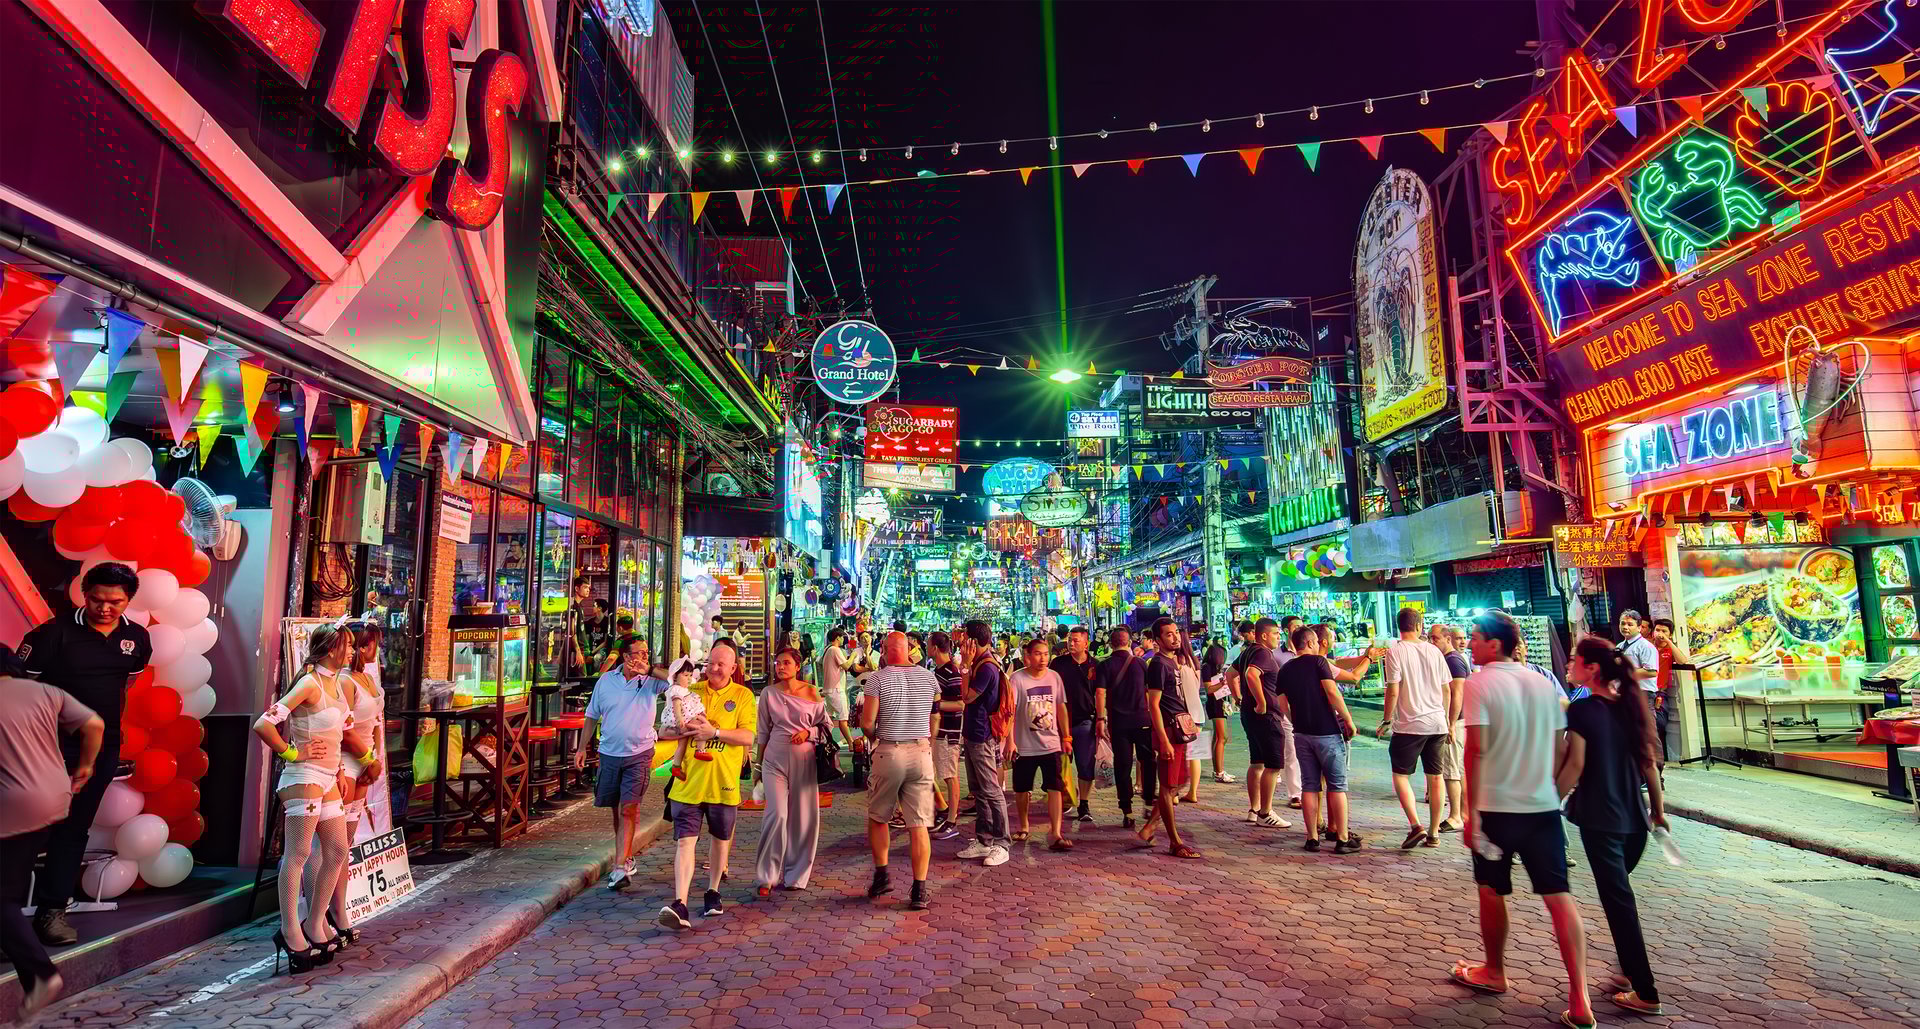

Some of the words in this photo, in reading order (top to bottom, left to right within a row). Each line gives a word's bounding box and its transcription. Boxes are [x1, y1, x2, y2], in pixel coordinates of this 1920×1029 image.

[1492, 47, 1619, 227] SEA
[1379, 208, 1401, 247] POT
[1422, 214, 1436, 278] FRESH
[1424, 281, 1438, 321] SEA
[1582, 313, 1665, 371] WELCOME
[1661, 300, 1695, 337] TO
[1697, 279, 1747, 322] SEA
[1746, 243, 1820, 302] ZONE
[1749, 292, 1850, 358] EXCELLENT
[1428, 322, 1442, 378] FOOD
[818, 367, 855, 380] Grand
[857, 368, 889, 380] Hotel
[1208, 361, 1274, 383] LOBSTER
[1279, 362, 1309, 377] POT
[1566, 388, 1605, 423] CLEAN
[1669, 344, 1720, 386] TASTE
[1147, 392, 1207, 410] LIGHTH
[1212, 394, 1252, 403] SEAFOOD
[1254, 394, 1308, 403] RESTAURANT
[1423, 388, 1445, 411] FOOD
[892, 417, 955, 428] SUGARBABY
[1200, 410, 1209, 418] A
[1210, 410, 1231, 418] GO
[1232, 410, 1252, 418] GO
[890, 425, 934, 434] AGO-GO
[1624, 423, 1680, 477] SEA
[1682, 390, 1784, 464] ZONE
[1268, 484, 1342, 536] LIGHTHOUSE
[1011, 536, 1038, 546] CLUB
[1572, 553, 1628, 567] 价格公平
[457, 631, 496, 640] POPCORN
[690, 737, 726, 753] Cang
[363, 833, 398, 857] BLISS
[384, 846, 406, 863] HOUR
[367, 869, 387, 897] 75
[395, 872, 410, 886] DRINKS
[351, 894, 370, 908] DRINKS
[361, 905, 373, 916] PM
[403, 882, 412, 893] PM
